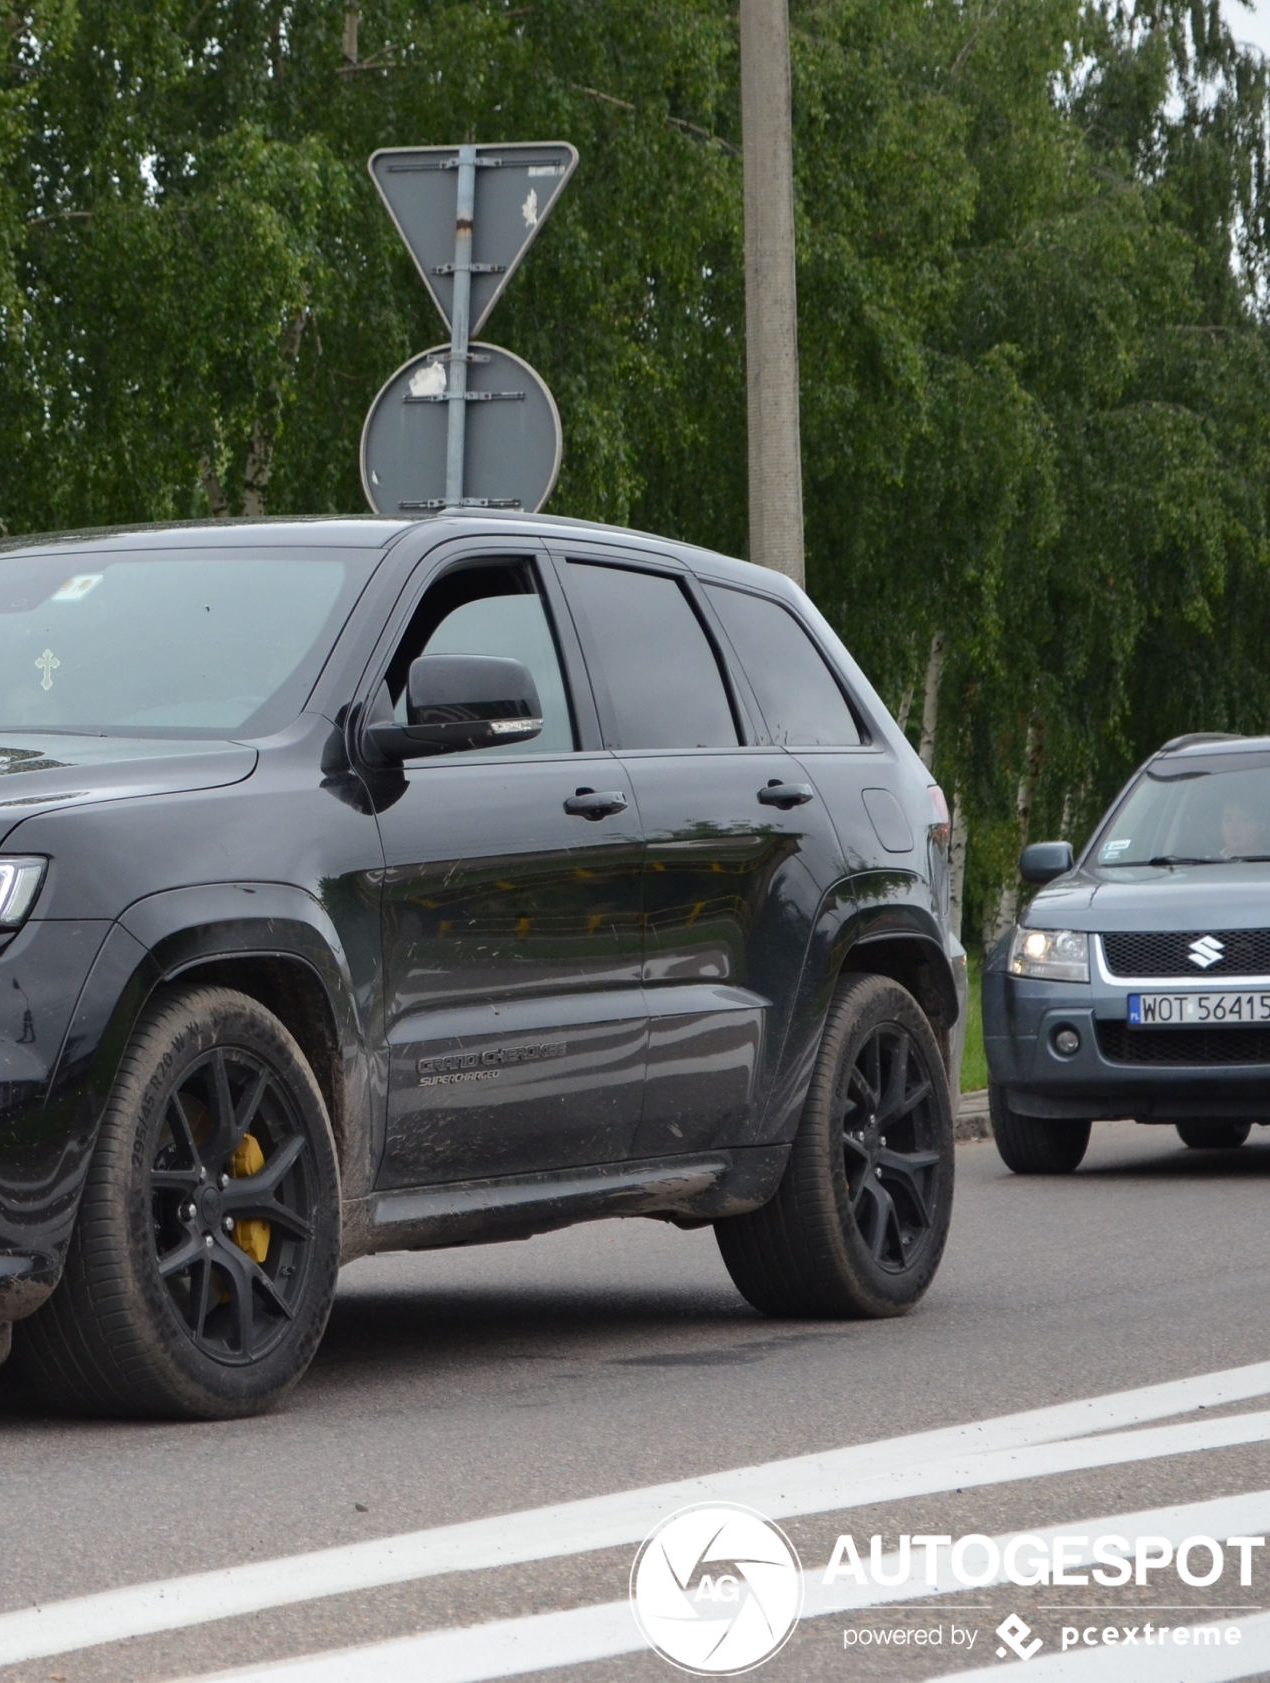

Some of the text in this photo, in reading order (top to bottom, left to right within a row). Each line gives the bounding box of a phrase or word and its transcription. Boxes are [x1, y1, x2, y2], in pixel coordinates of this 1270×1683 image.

[1130, 1012, 1139, 1020] PL
[1142, 995, 1270, 1021] WOT 56415
[417, 1041, 567, 1073] GRAND CHEROKEE
[418, 1070, 500, 1087] SUPERCHARGED
[132, 1092, 155, 1168] 295/45
